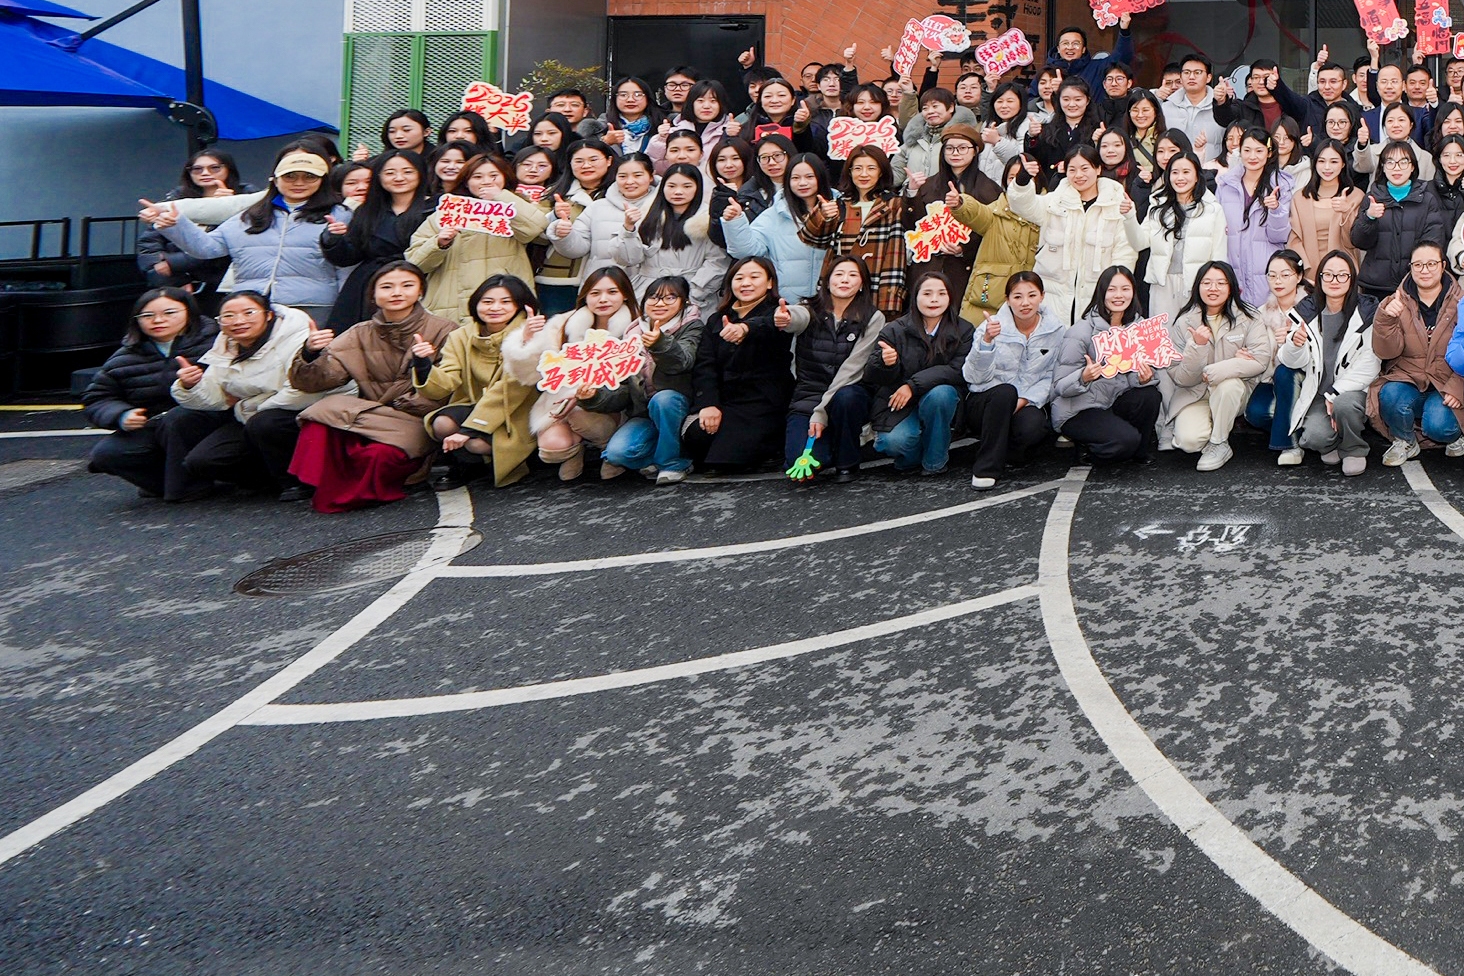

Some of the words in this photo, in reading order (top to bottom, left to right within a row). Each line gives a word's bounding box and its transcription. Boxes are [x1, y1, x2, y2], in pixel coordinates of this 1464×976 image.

[1023, 4, 1042, 16] HOOD
[923, 19, 945, 33] 红红
[923, 27, 941, 42] 火火
[466, 85, 530, 113] 2026
[830, 118, 894, 140] 2026
[438, 195, 515, 218] 加油2026
[439, 212, 512, 236] 我们一起赢
[1140, 314, 1168, 329] HAPPY
[1143, 324, 1161, 335] NEW
[1094, 325, 1145, 363] 财源
[1144, 329, 1169, 342] YEAR
[563, 336, 640, 363] 逐梦2026
[541, 355, 642, 391] 马到成功
